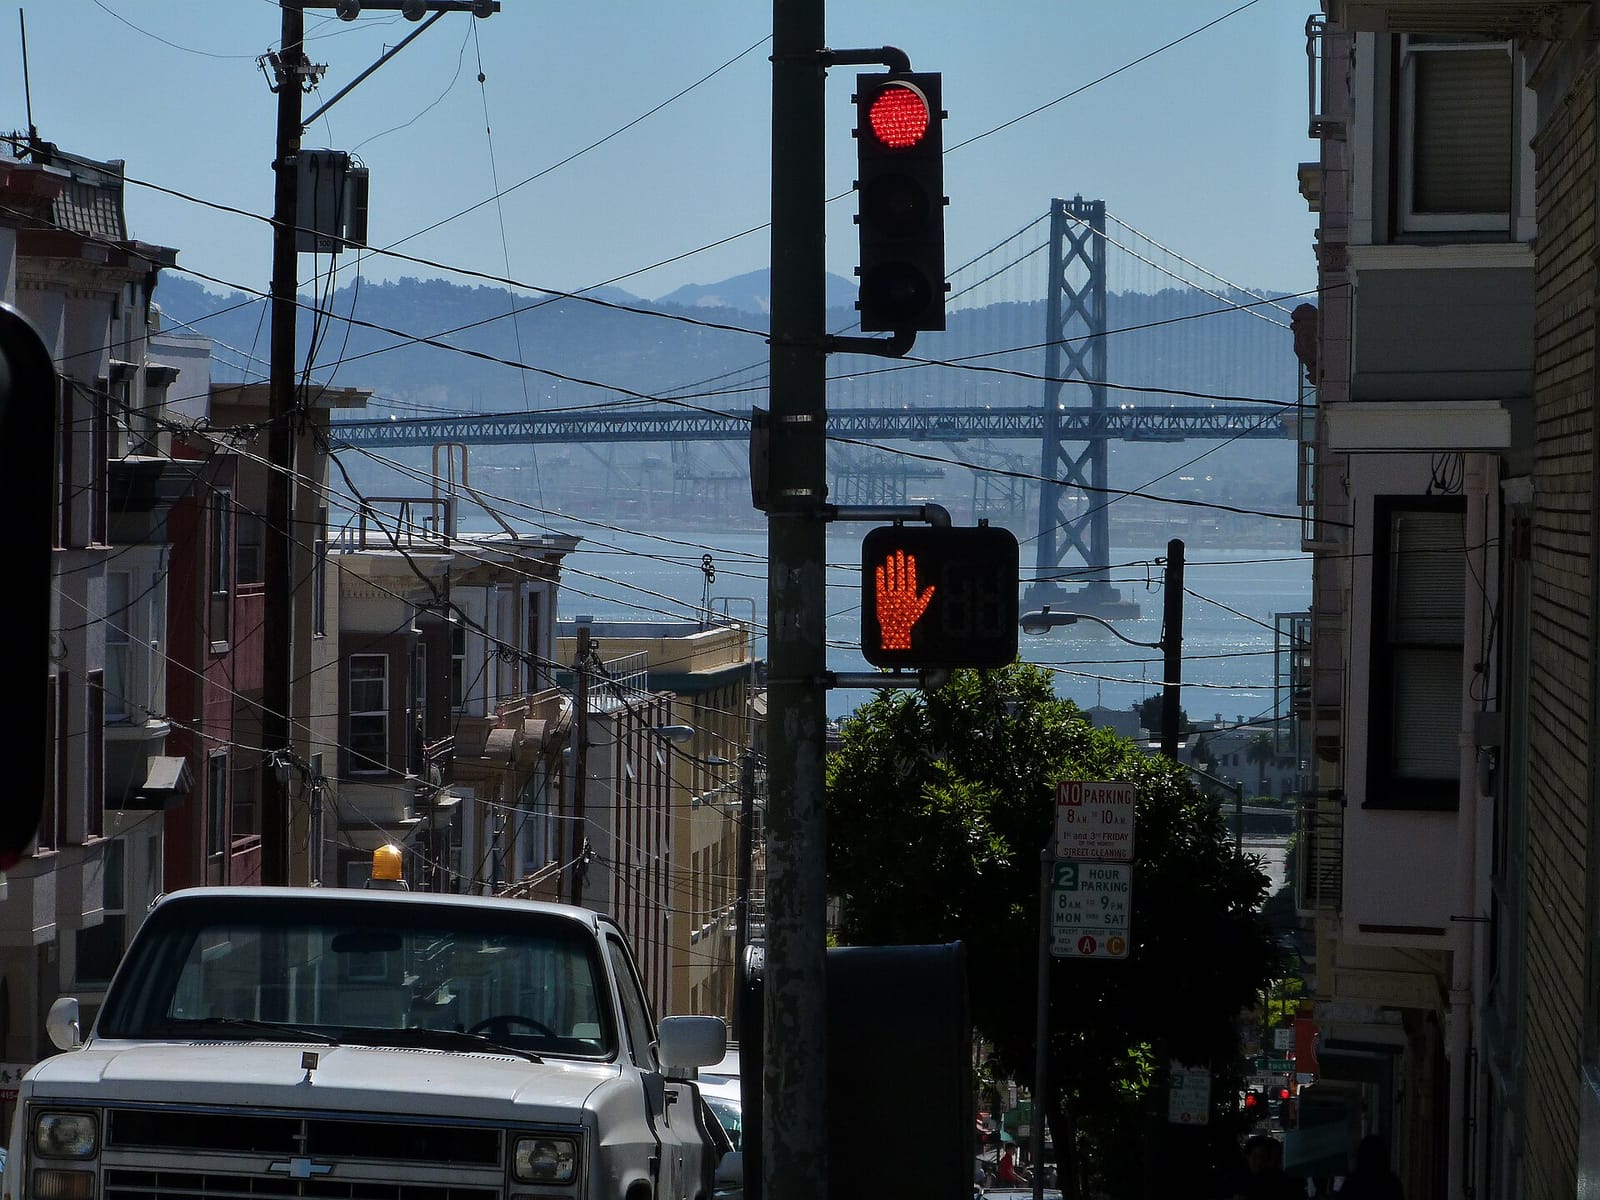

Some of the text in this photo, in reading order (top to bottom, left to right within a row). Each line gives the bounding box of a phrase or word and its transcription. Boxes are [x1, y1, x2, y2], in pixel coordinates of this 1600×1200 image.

[1060, 784, 1131, 804] NO PARKING
[1102, 832, 1129, 840] FRIDAY
[1063, 848, 1127, 857] STREET CLEANING
[1059, 867, 1120, 886] 2 HOUR
[1080, 881, 1128, 893] PARKING
[1056, 913, 1081, 923] MON
[1104, 914, 1125, 925] SAT
[1083, 938, 1091, 953] A
